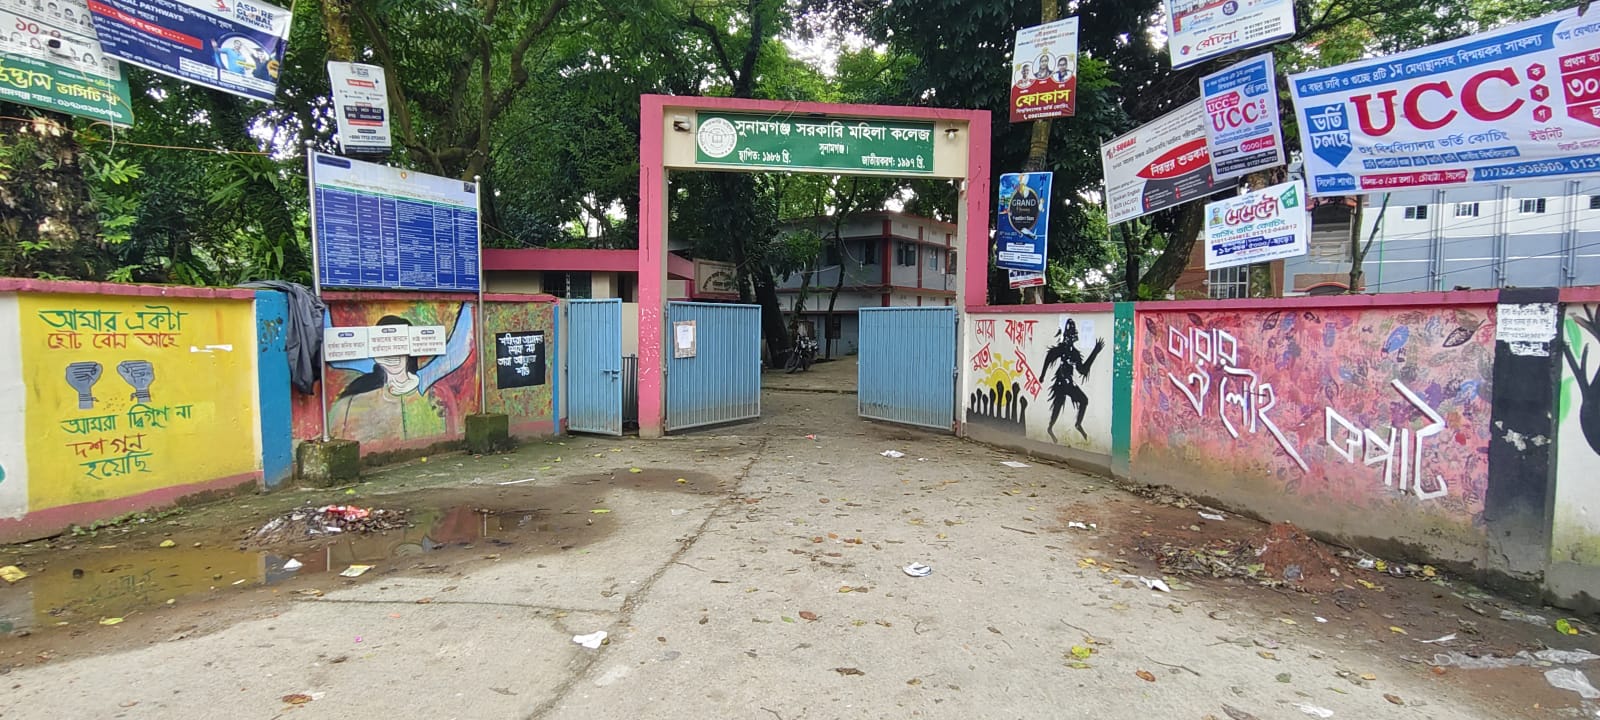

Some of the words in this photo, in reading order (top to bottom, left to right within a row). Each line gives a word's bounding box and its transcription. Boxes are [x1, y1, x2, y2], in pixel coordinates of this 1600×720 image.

[139, 1, 185, 22] PATHWAYS
[236, 15, 273, 31] PATHWAYS
[15, 17, 39, 35] ১০
[1573, 22, 1600, 38] যেখা
[1307, 81, 1324, 92] বছর
[1325, 77, 1341, 89] ঢাবি
[1373, 68, 1386, 81] ৪টি
[1389, 64, 1403, 79] ১ম
[1406, 54, 1456, 75] মেধাস্থানসহ
[1457, 43, 1502, 64] বিস্ময়কর
[1505, 34, 1543, 52] সাফল্য
[1563, 55, 1586, 69] প্রথম
[1016, 89, 1072, 107] ফোকাস
[1349, 66, 1526, 137] UCC
[1567, 78, 1600, 98] ৩০
[1208, 98, 1229, 112] UCC
[1211, 102, 1259, 133] UCC
[1310, 104, 1343, 131] ভর্তি
[734, 119, 791, 138] সুনামগঞ্জ
[795, 121, 845, 138] সরকারি
[847, 123, 887, 142] মহিলা
[889, 127, 932, 143] কলেজ
[1311, 131, 1352, 149] চলছে
[1359, 144, 1374, 156] শুধু
[1375, 139, 1435, 155] বিশ্ববিদ্যালয়
[1438, 133, 1464, 148] ভর্তি
[1468, 129, 1512, 145] কোচিং
[1528, 127, 1564, 142] ইউনিট
[1012, 199, 1036, 207] GRAND
[1225, 193, 1279, 226] মেমেন্টো
[39, 308, 123, 332] আমার
[125, 305, 189, 331] একটা
[48, 330, 82, 350] ছোট
[134, 331, 183, 348] আছে
[975, 319, 997, 346] মোরা
[1167, 326, 1238, 372] কারার
[1015, 346, 1043, 402] উদ্দাম
[60, 414, 119, 440] আমরা
[175, 404, 194, 420] না
[1167, 362, 1212, 417] ঐ
[1218, 364, 1310, 474] লৌহ
[66, 438, 107, 463] দশ
[1323, 378, 1449, 501] কপাট
[80, 452, 154, 481] হয়েছি
